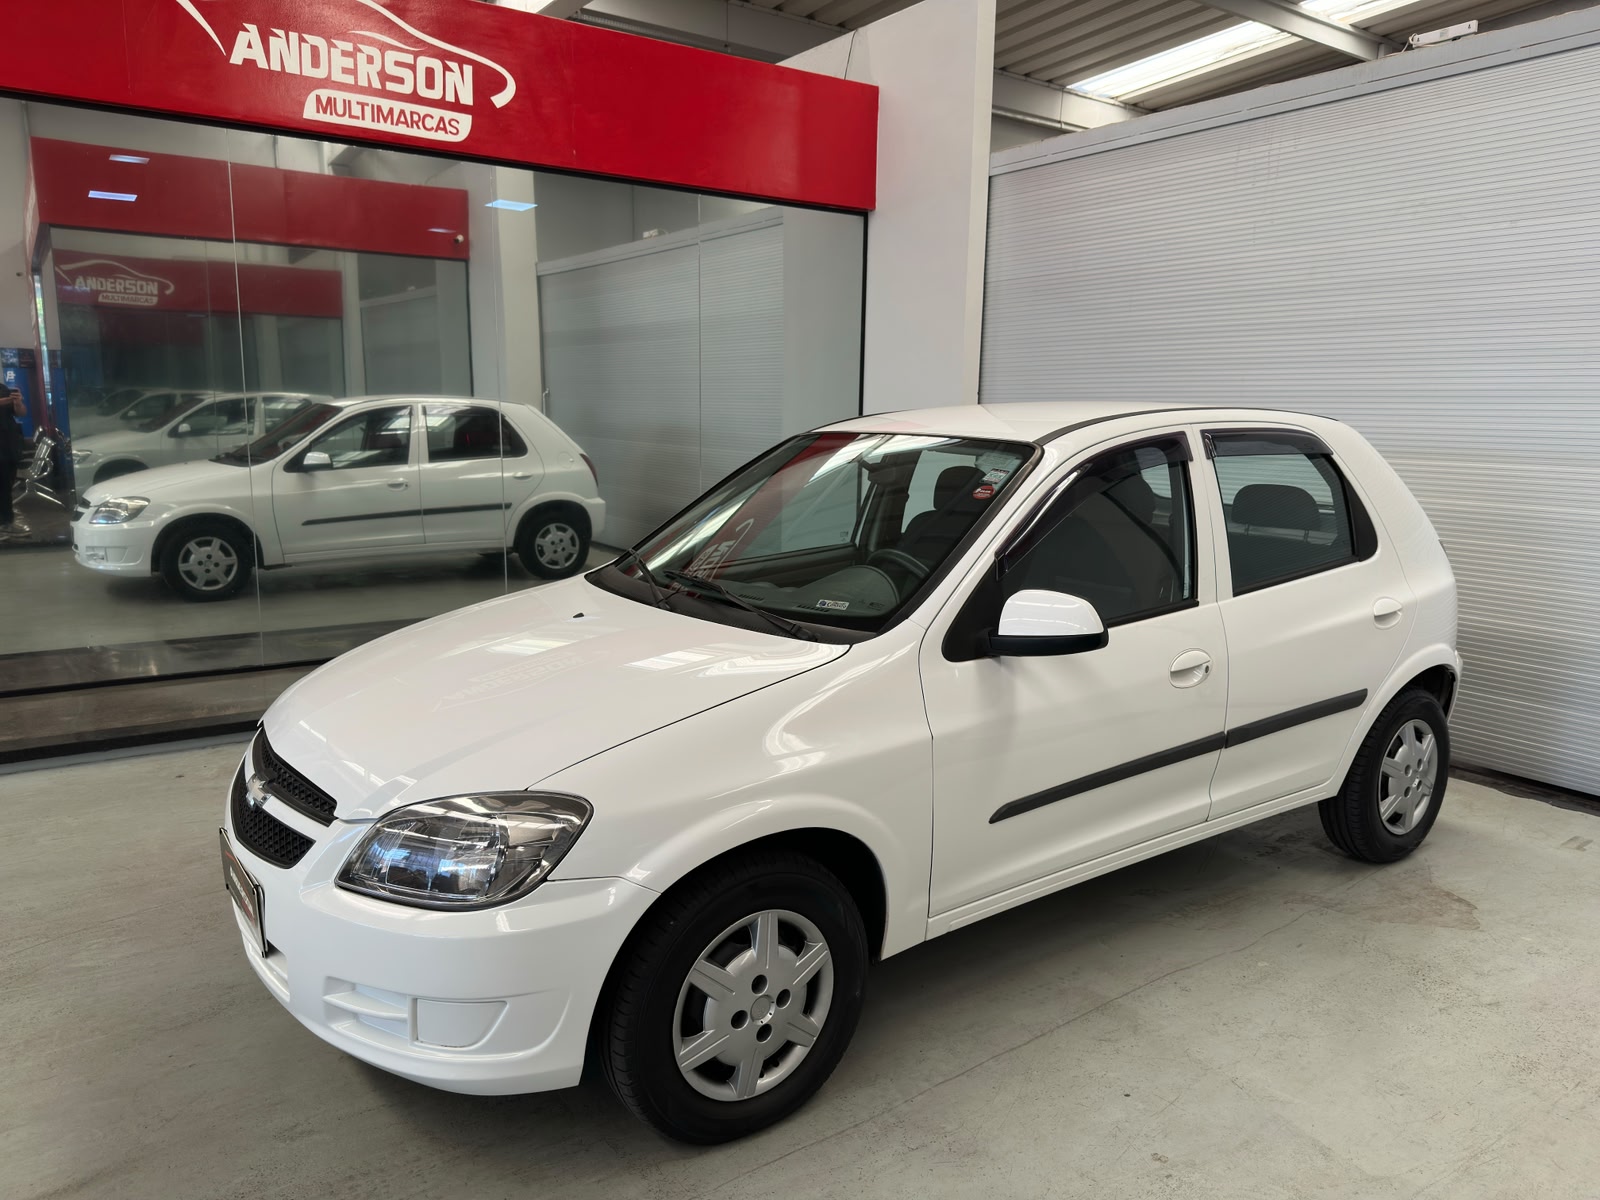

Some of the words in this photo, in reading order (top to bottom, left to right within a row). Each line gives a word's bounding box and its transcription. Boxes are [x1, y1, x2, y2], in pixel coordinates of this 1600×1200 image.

[229, 22, 474, 106] ANDERSON
[315, 93, 460, 137] MULTIMARCAS
[75, 275, 159, 295] ANDERSON
